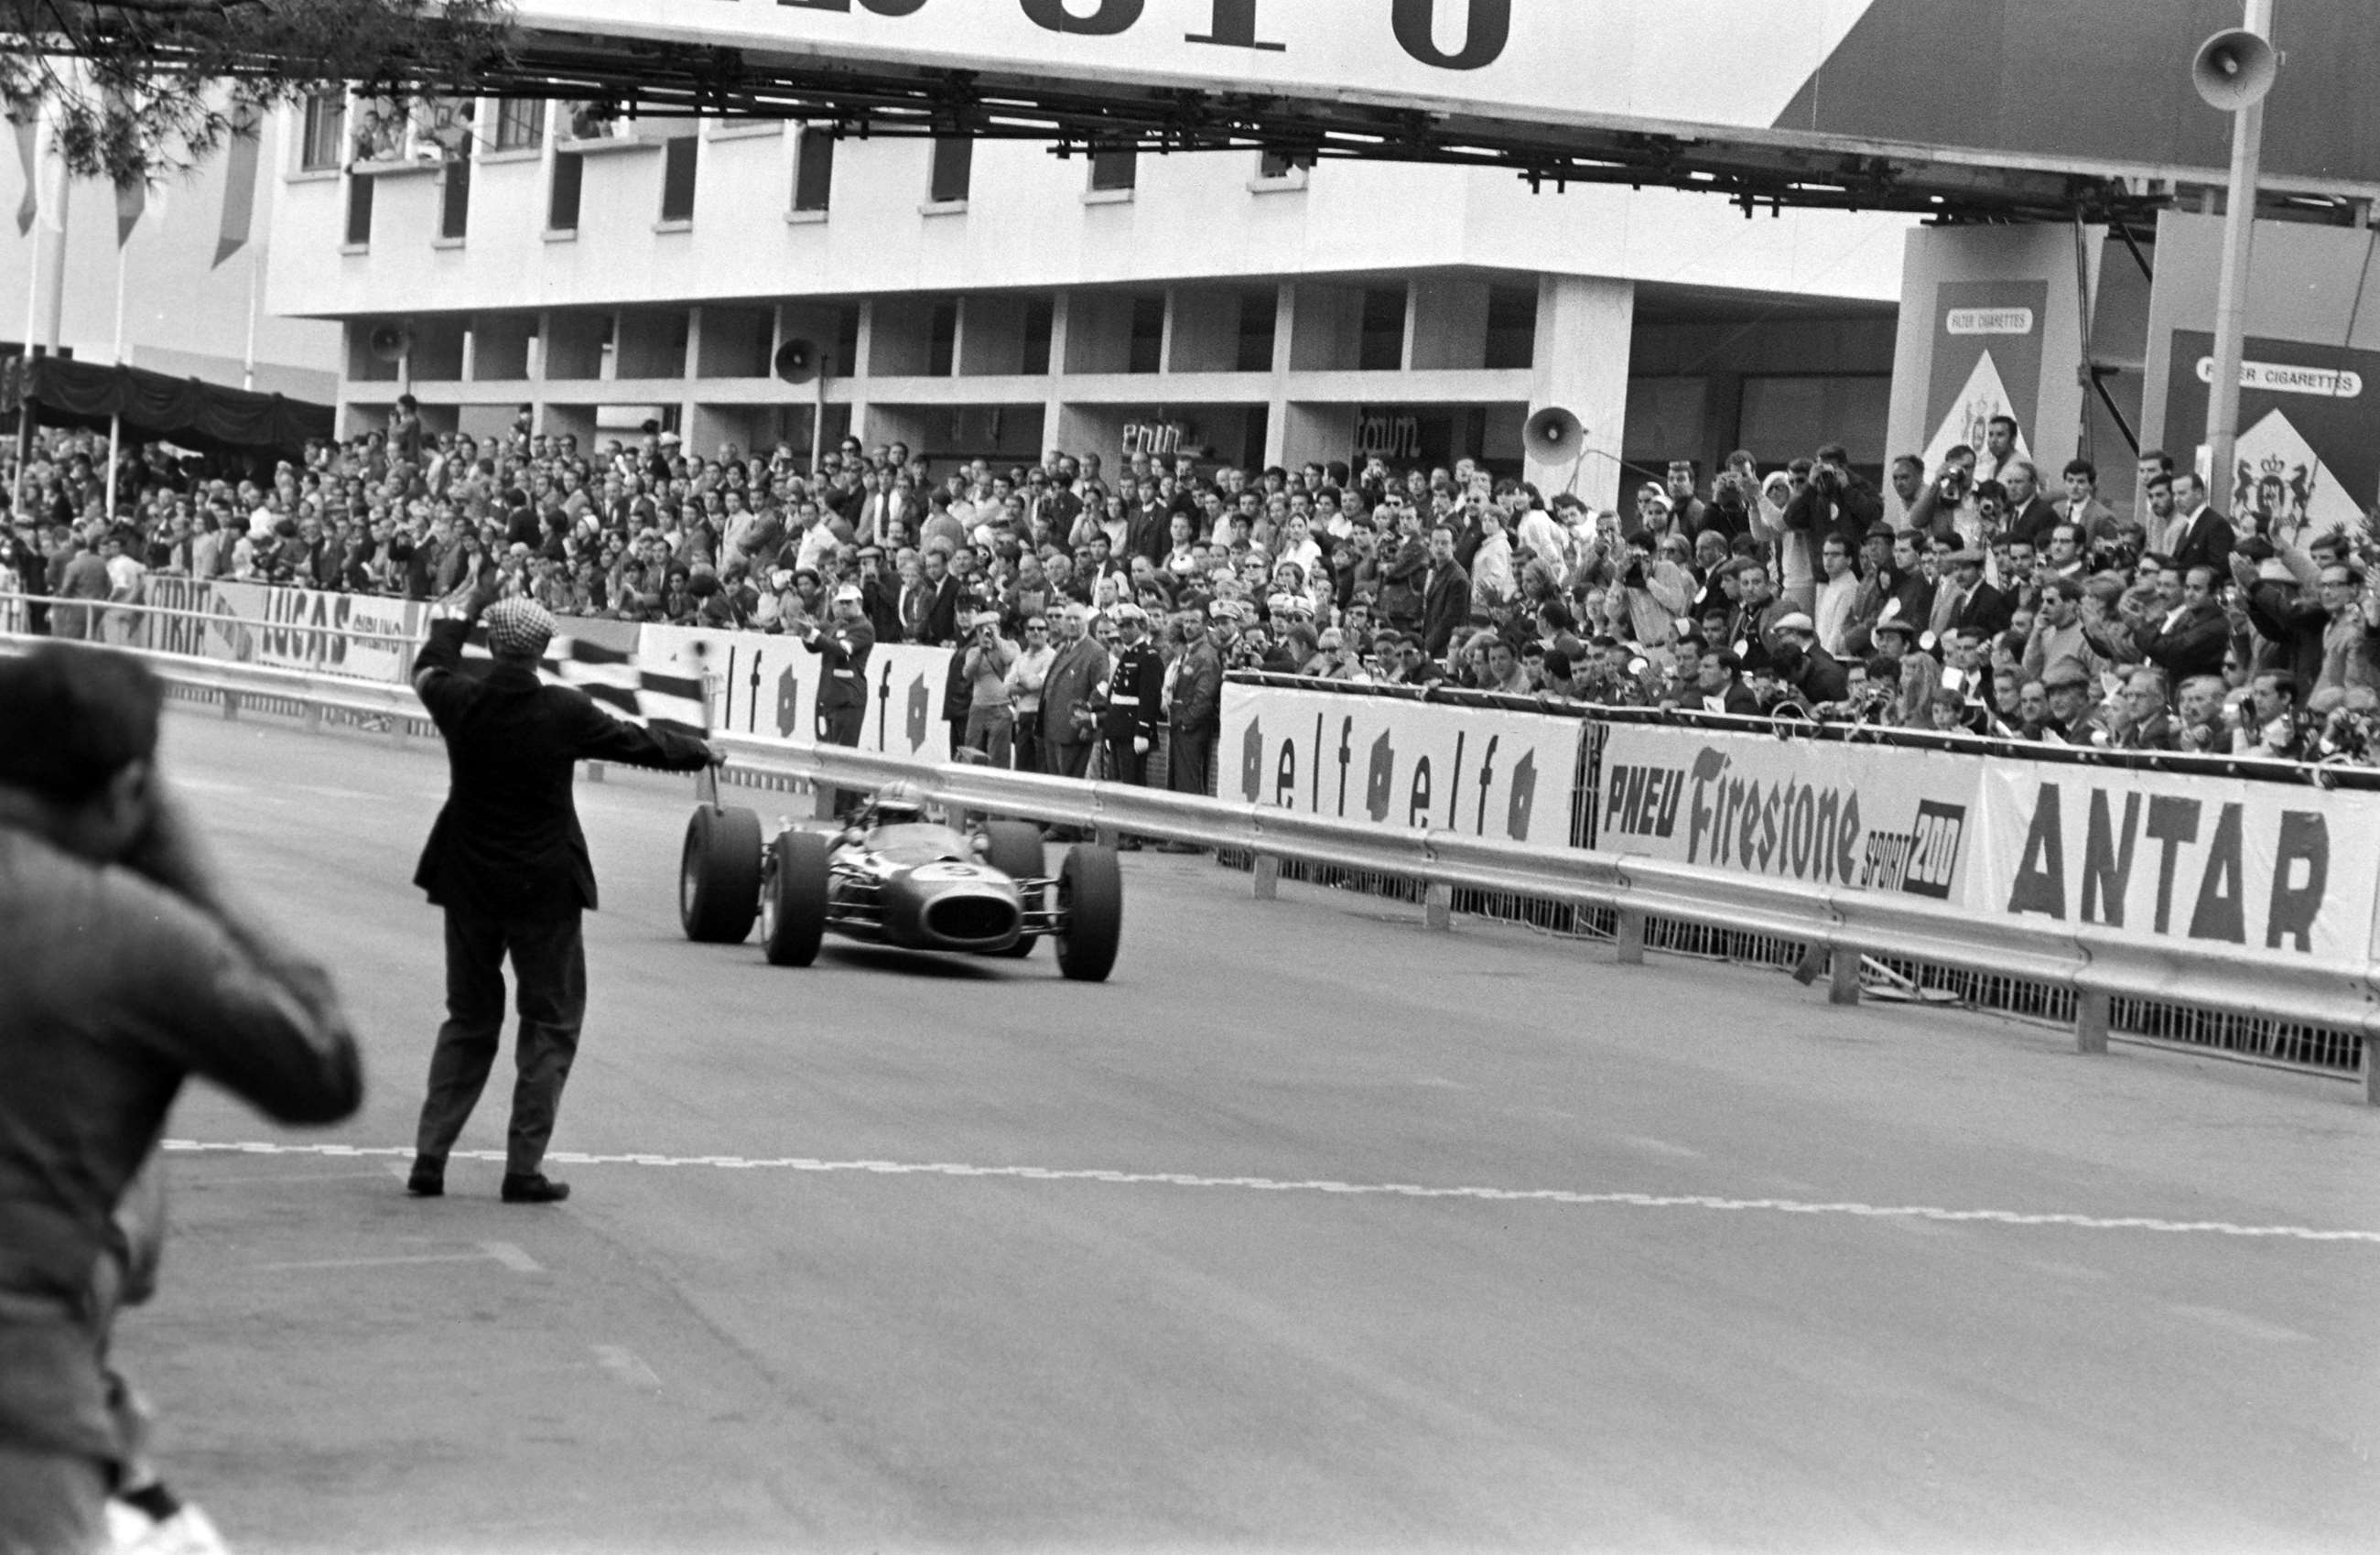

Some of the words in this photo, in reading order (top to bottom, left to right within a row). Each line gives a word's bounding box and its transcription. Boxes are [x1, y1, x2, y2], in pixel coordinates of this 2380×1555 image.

[2265, 369, 2353, 392] CIGARETTES
[262, 587, 352, 665] LUCAS
[724, 644, 763, 733] lf
[1276, 712, 1352, 817] elf
[1410, 729, 1499, 837] elf
[1604, 765, 1685, 838] PNEU
[1687, 746, 1861, 885] Firestone
[1907, 813, 1960, 887] 200
[2007, 782, 2330, 954] ANTAR
